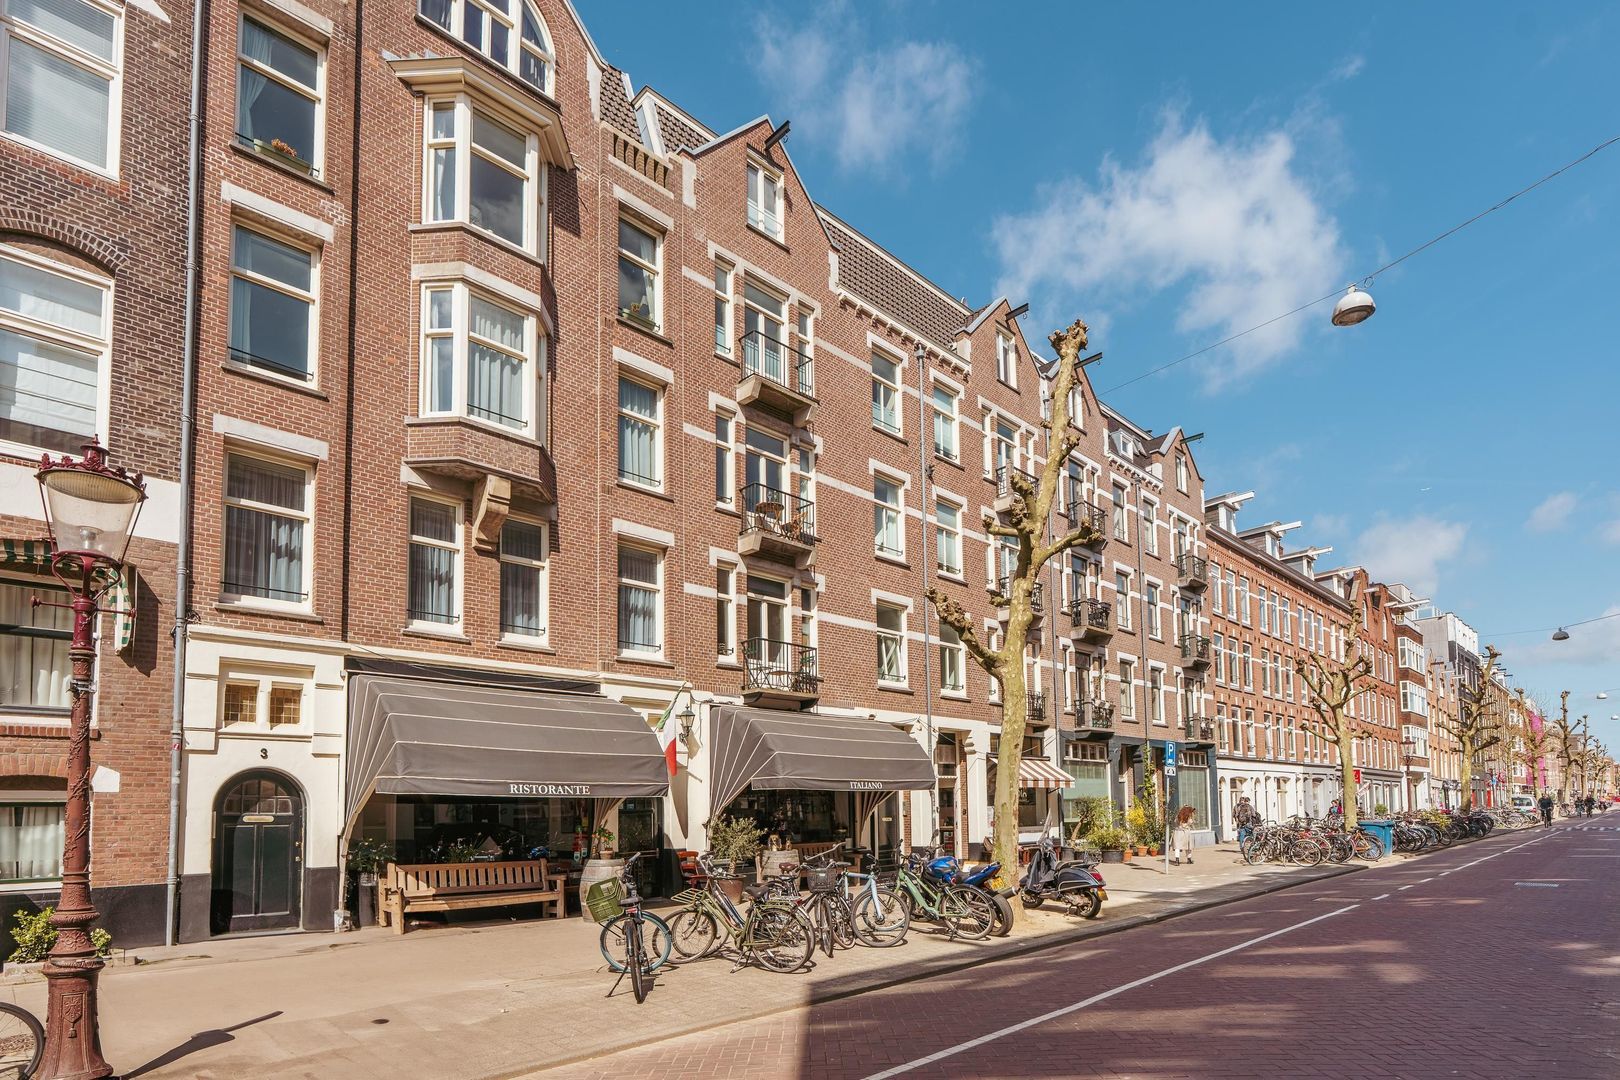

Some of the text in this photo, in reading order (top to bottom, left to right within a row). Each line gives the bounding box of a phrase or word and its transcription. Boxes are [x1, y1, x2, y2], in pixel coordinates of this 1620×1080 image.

[260, 748, 268, 760] 3
[1168, 743, 1174, 756] P
[509, 783, 591, 795] RISTORANTE
[850, 781, 883, 790] ITALIANO
